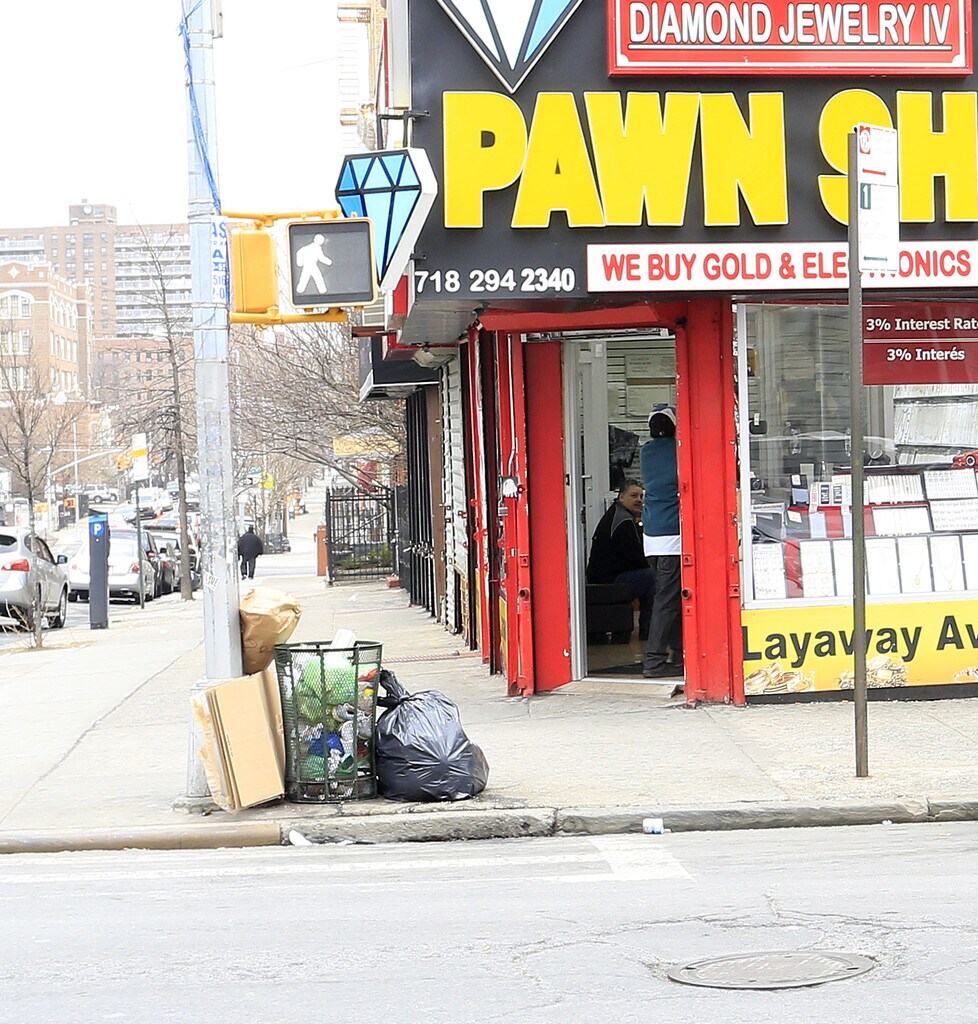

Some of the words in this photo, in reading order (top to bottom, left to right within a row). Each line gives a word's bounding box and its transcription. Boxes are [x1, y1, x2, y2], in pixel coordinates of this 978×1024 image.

[628, 0, 773, 45] DIAMOND
[778, 2, 915, 45] JEWELRY
[922, 3, 952, 46] IV
[442, 90, 790, 229] PAWN
[414, 270, 460, 293] 718
[469, 269, 517, 293] 294
[520, 267, 575, 293] 2340
[602, 254, 642, 281] WE
[648, 253, 698, 280] BUY
[703, 252, 772, 280] GOLD
[779, 252, 796, 279] &
[803, 250, 971, 280] ELEONICS
[866, 318, 892, 331] 3%
[894, 318, 951, 331] Interest
[886, 348, 912, 361] 3%
[915, 347, 965, 361] Interés
[742, 625, 923, 668] Layaway
